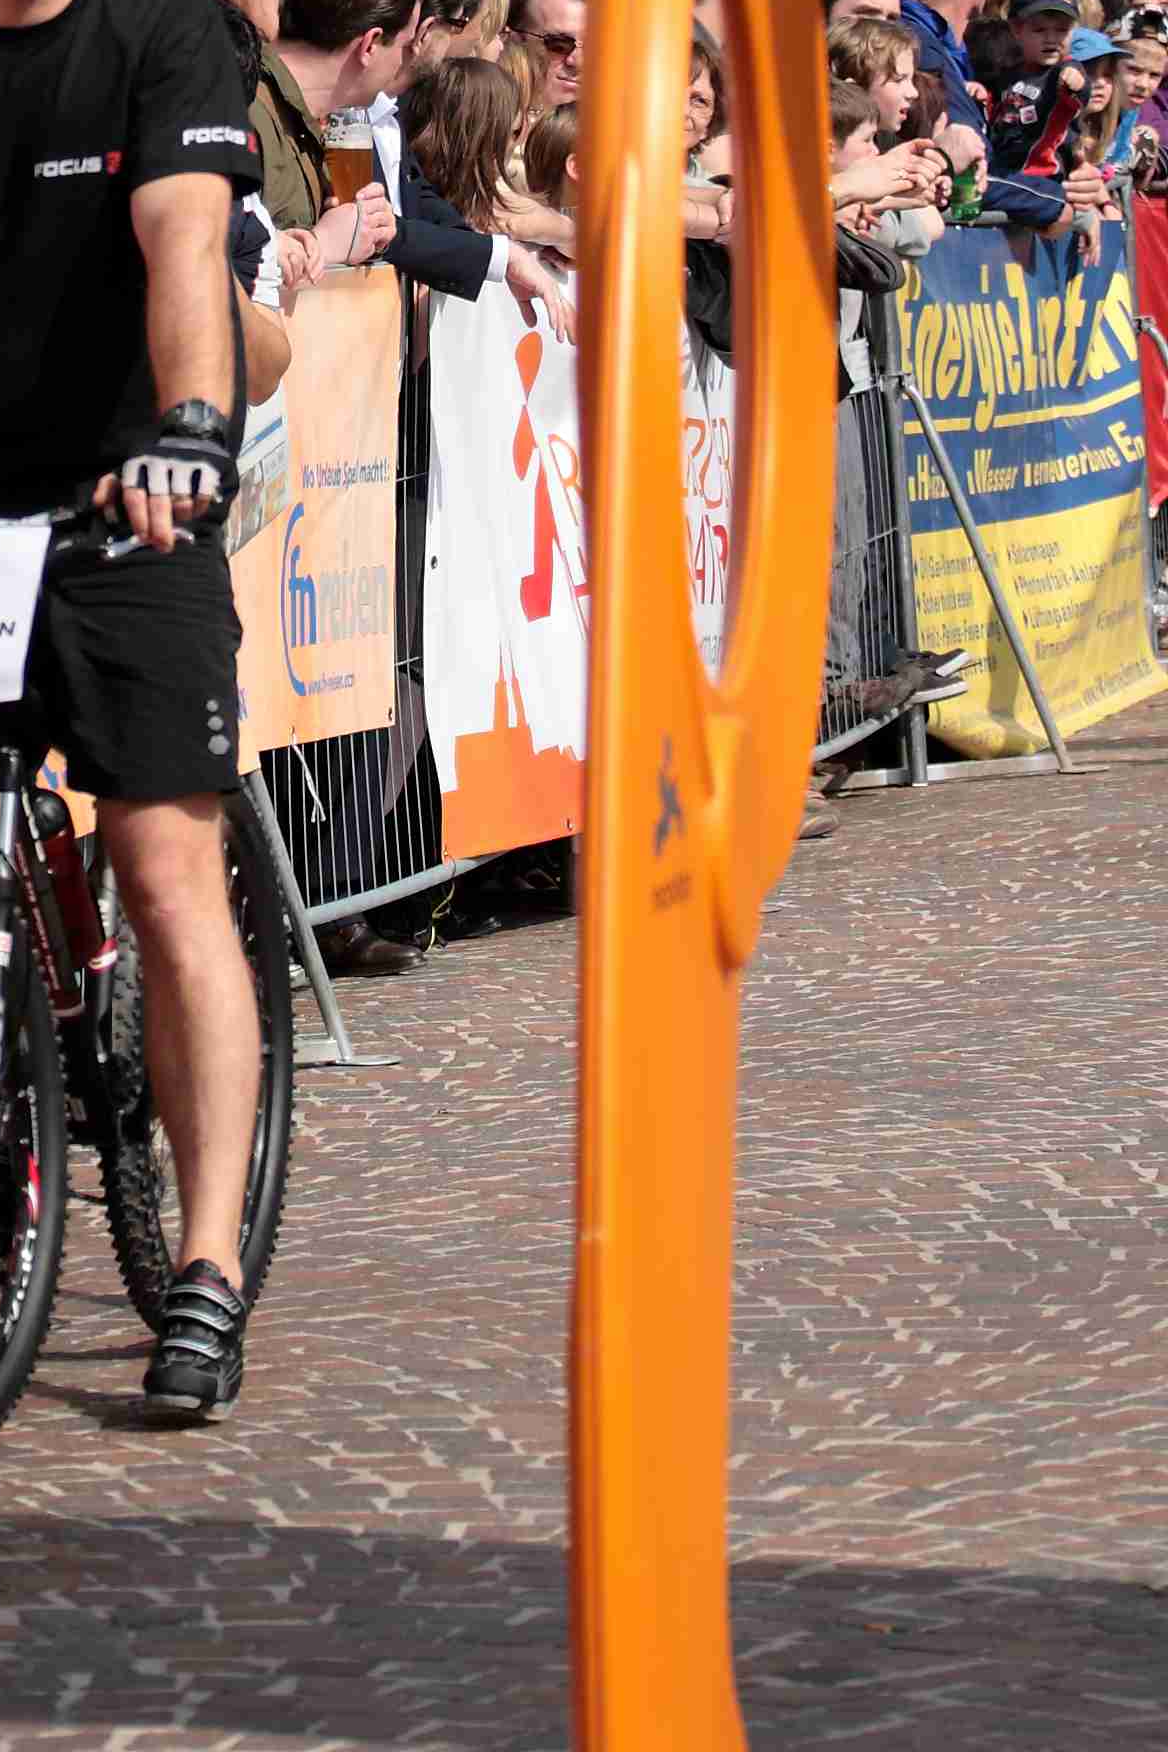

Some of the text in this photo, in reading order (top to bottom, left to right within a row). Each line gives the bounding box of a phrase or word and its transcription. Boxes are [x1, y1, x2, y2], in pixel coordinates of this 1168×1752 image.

[182, 125, 247, 146] FOCUS
[34, 156, 102, 178] FOCUS
[974, 448, 1019, 494] Wasser
